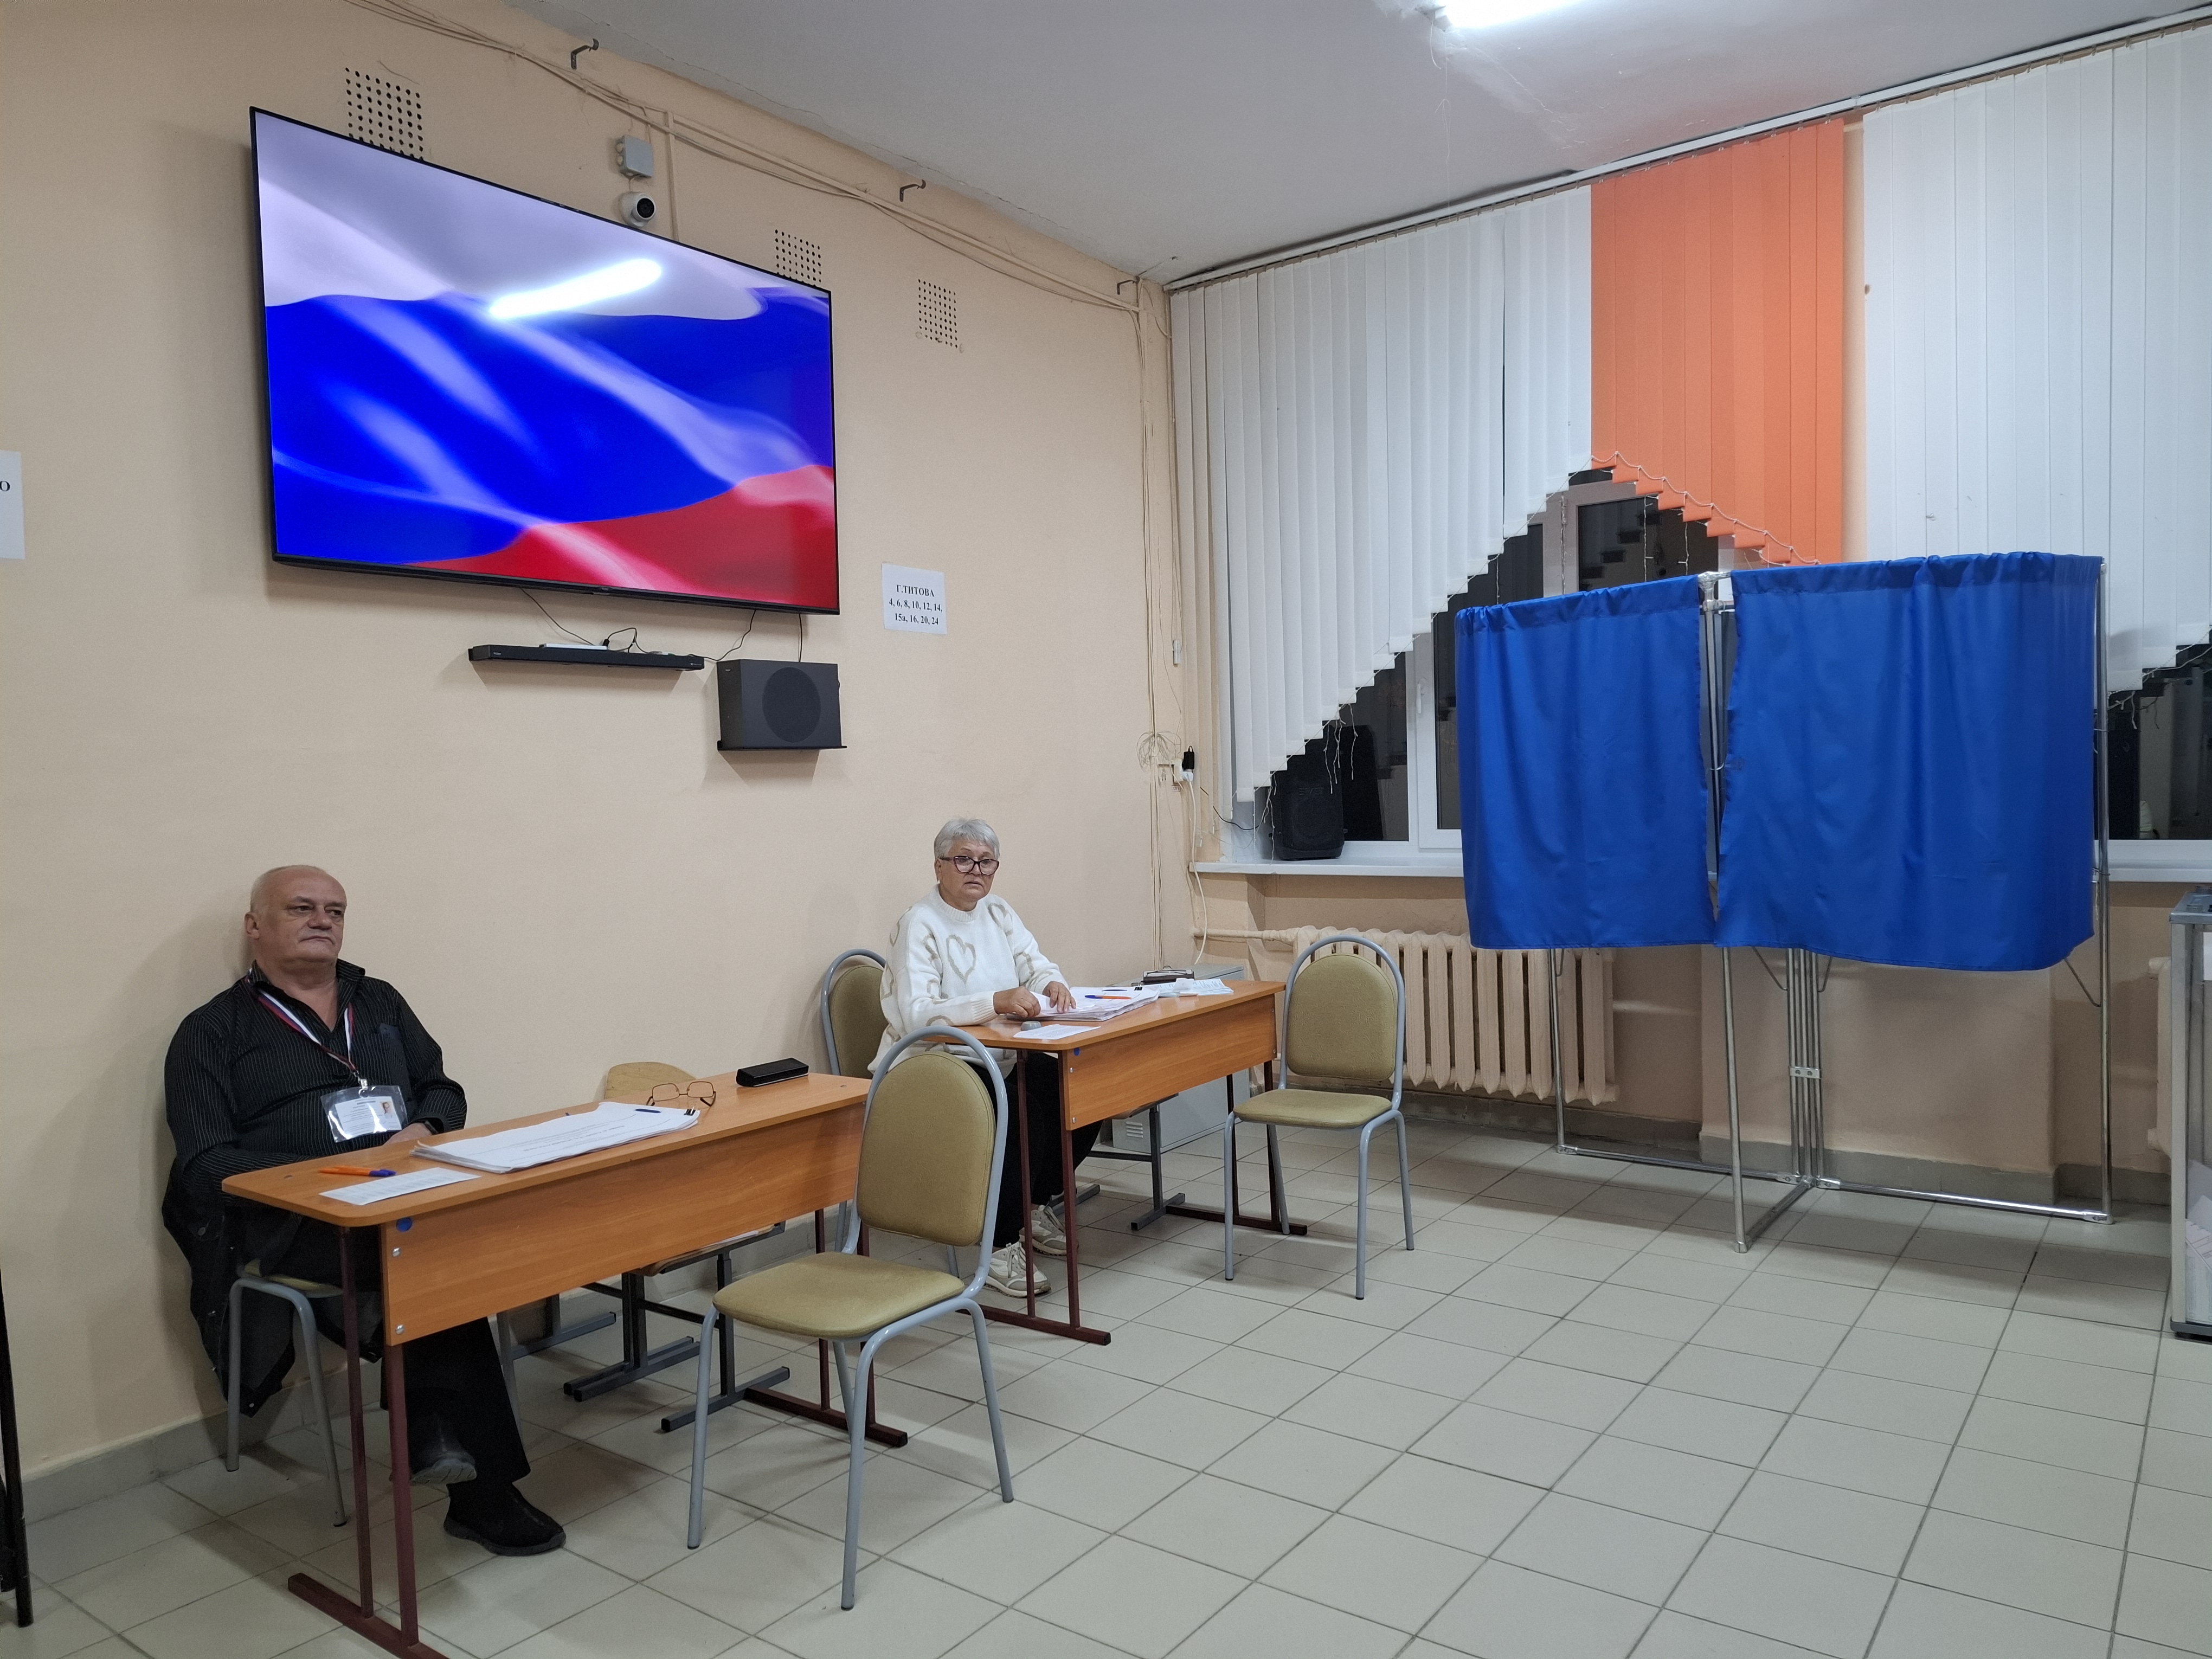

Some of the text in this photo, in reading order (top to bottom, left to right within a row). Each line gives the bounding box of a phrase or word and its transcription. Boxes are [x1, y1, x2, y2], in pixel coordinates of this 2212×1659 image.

[896, 584, 935, 597] Г.ТИТОВА
[889, 598, 943, 613] 4, 6, 8, 10, 12, 14,
[910, 615, 919, 624] 16,
[921, 616, 930, 625] 20,
[931, 617, 939, 625] 24
